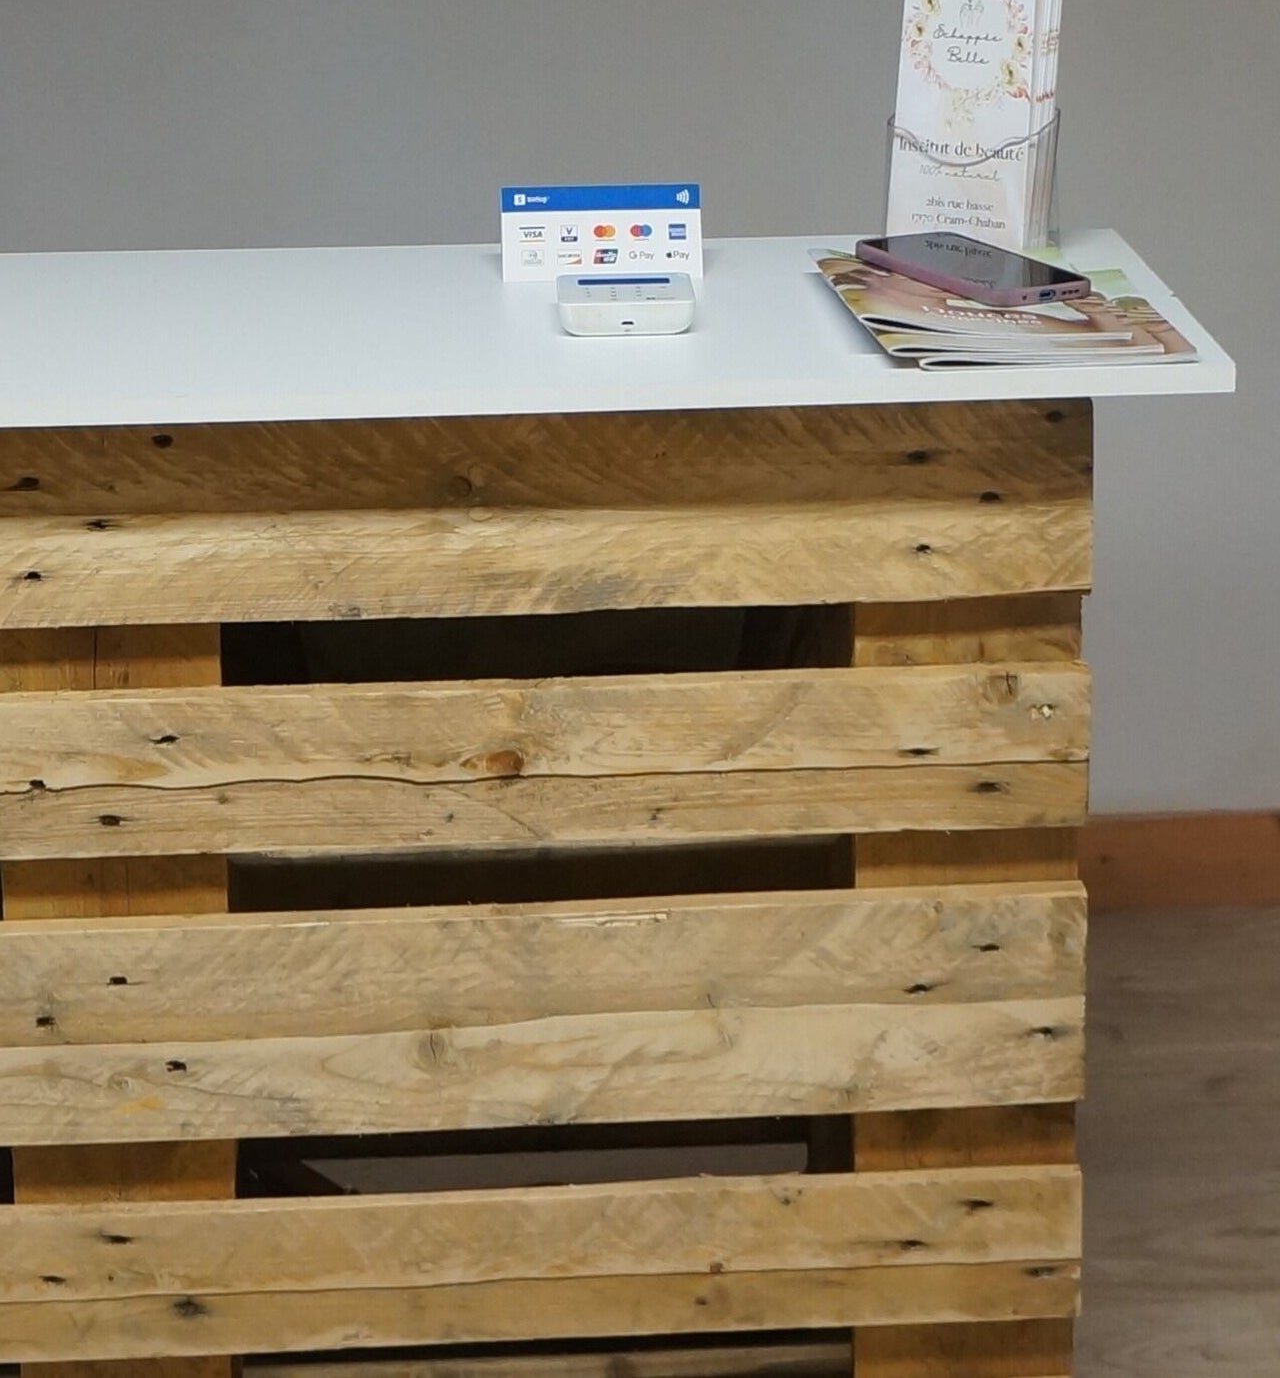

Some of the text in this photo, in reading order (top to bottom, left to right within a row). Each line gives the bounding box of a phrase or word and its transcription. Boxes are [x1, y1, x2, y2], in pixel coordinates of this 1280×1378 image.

[947, 45, 990, 64] Belle
[898, 136, 1024, 161] Institut de beauté
[947, 200, 964, 210] rue
[966, 199, 994, 212] basse
[523, 230, 543, 239] VISA
[639, 251, 655, 261] Pay
[673, 250, 690, 261] Pay
